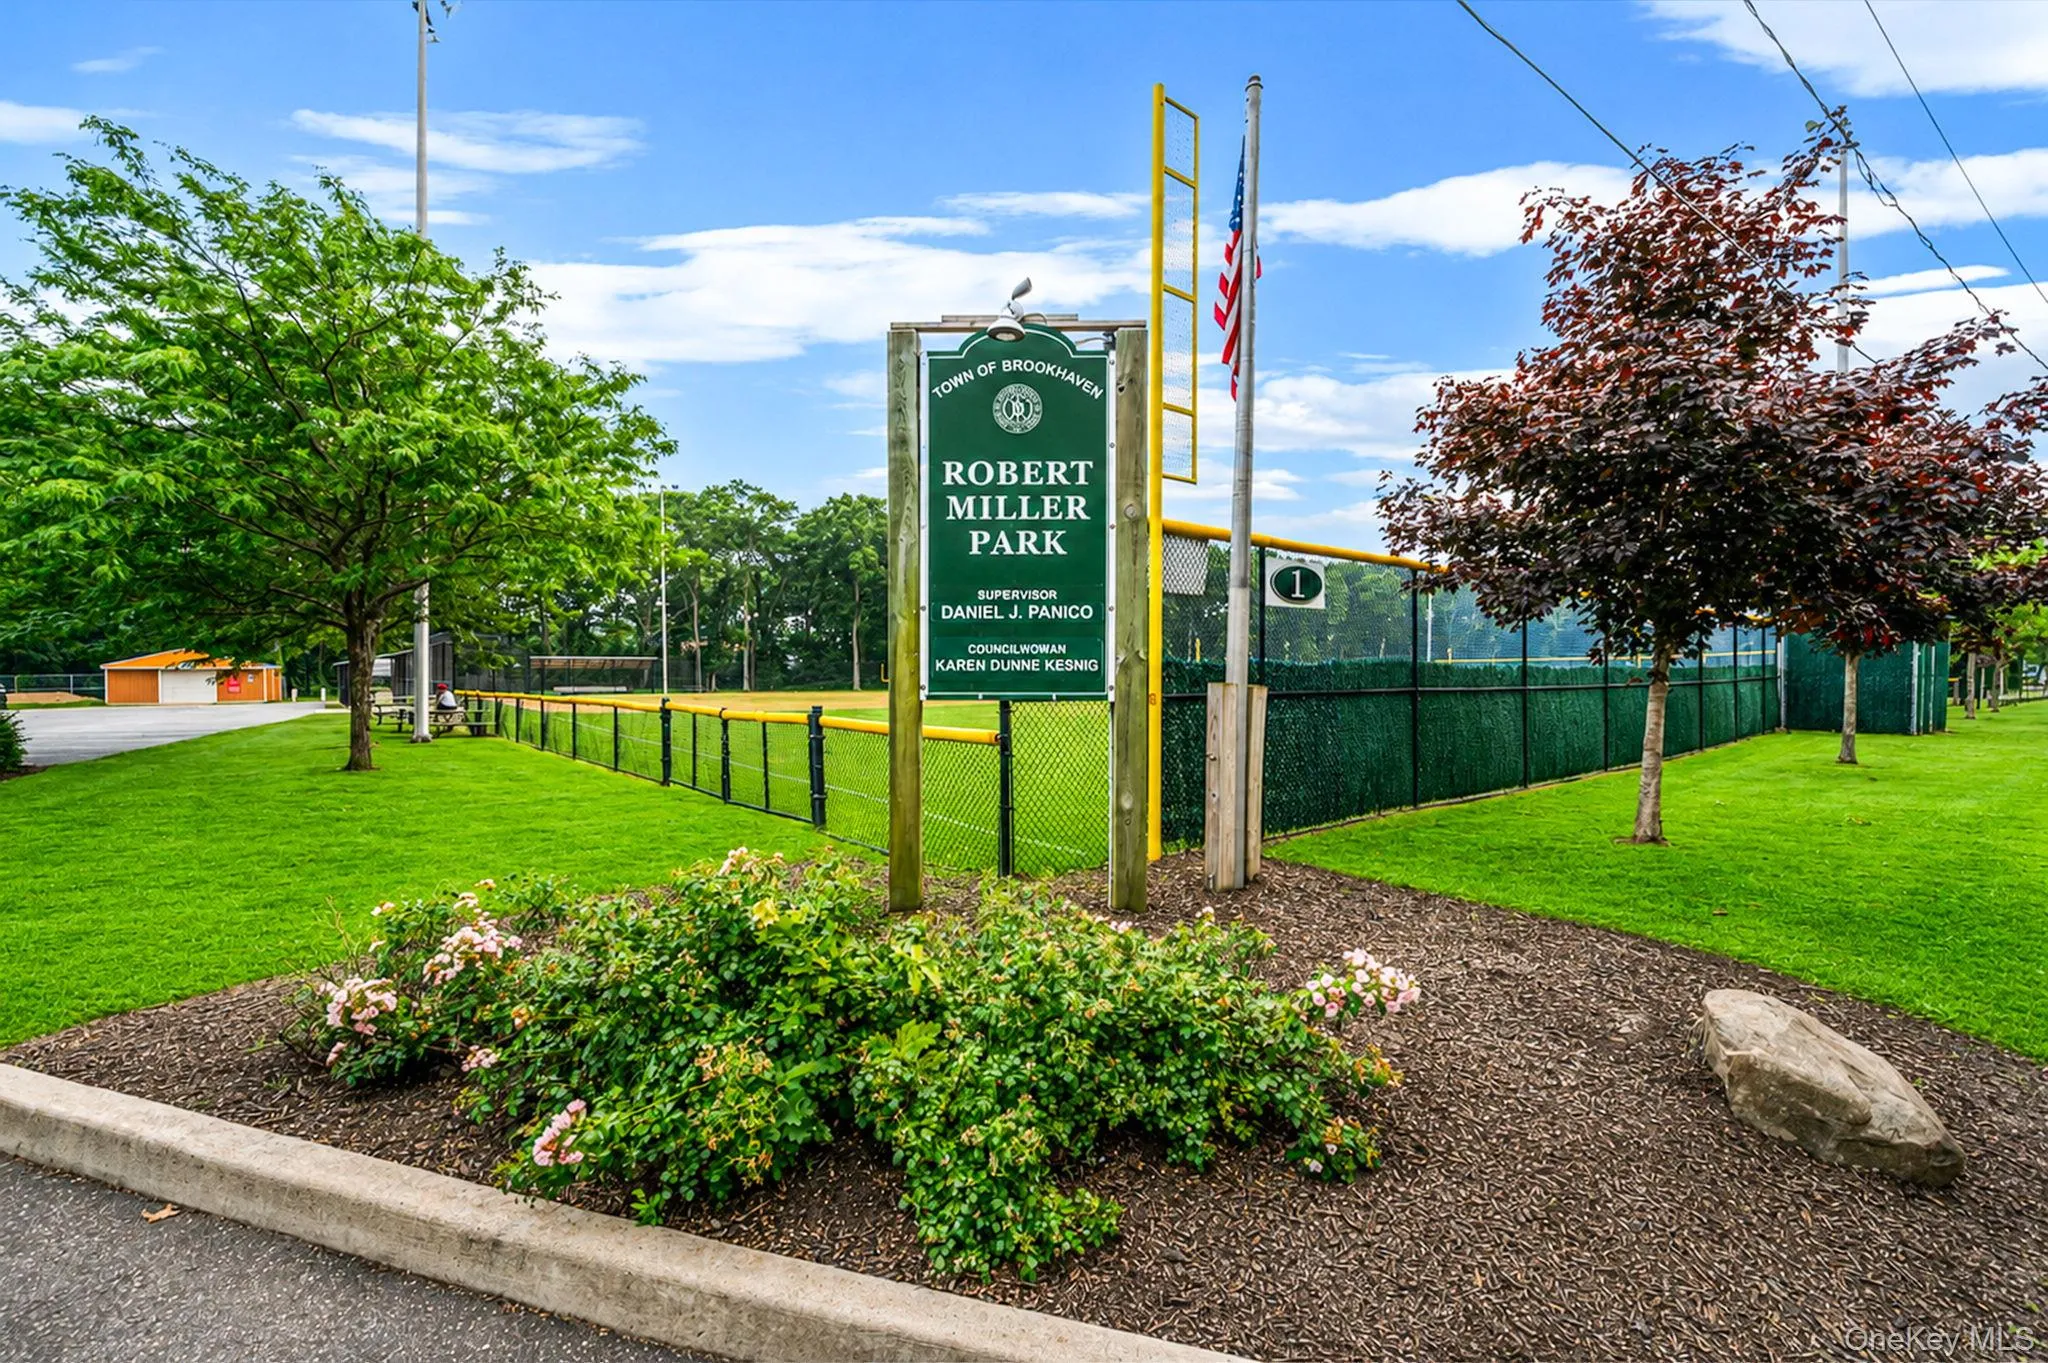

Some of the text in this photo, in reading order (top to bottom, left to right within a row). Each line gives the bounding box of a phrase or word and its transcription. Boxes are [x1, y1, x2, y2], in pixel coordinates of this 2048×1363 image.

[932, 359, 1103, 400] TOWN OF BROOKHAVEN
[942, 460, 1093, 486] ROBERT
[946, 495, 1091, 520] MILLER
[969, 530, 1067, 555] PARK
[977, 589, 1057, 600] SUPERVISOR
[1291, 569, 1305, 598] 1
[941, 605, 1093, 619] DANIEL J. PANICO
[935, 659, 1099, 671] KAREN DUNNE KESNIG
